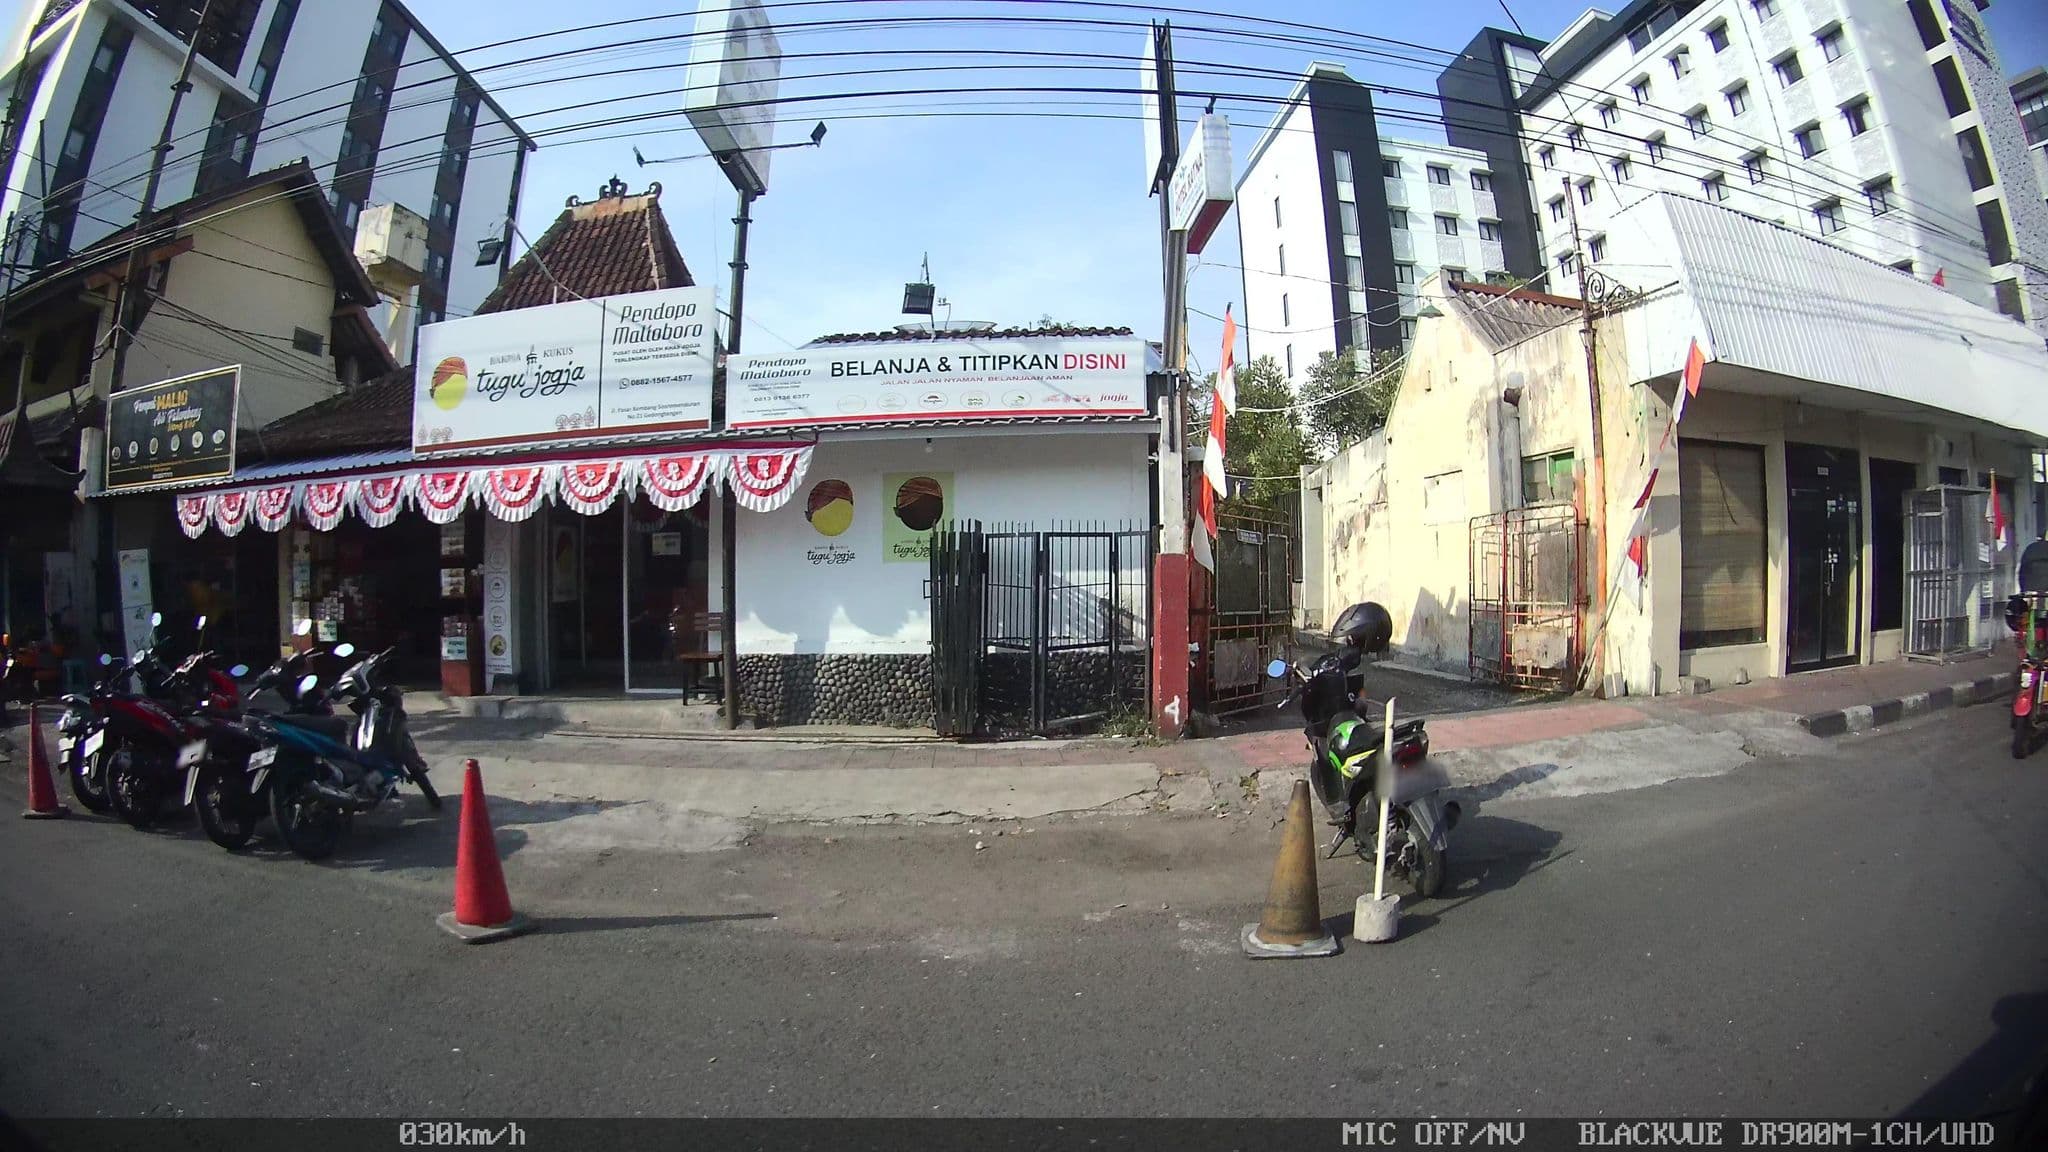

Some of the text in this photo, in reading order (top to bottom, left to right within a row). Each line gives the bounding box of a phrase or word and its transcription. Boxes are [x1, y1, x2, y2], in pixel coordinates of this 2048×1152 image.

[620, 302, 697, 324] Pendopo
[612, 323, 703, 345] Malioboro
[543, 346, 575, 358] KUKUS
[748, 357, 807, 369] Pendopo
[831, 353, 1127, 377] BELANJA & TITIPKAN DISINI
[477, 360, 586, 402] tugu jogja
[740, 368, 812, 381] Malioboro
[156, 389, 188, 411] MALIO
[807, 549, 856, 565] tugu jogja
[893, 543, 917, 558] tugu
